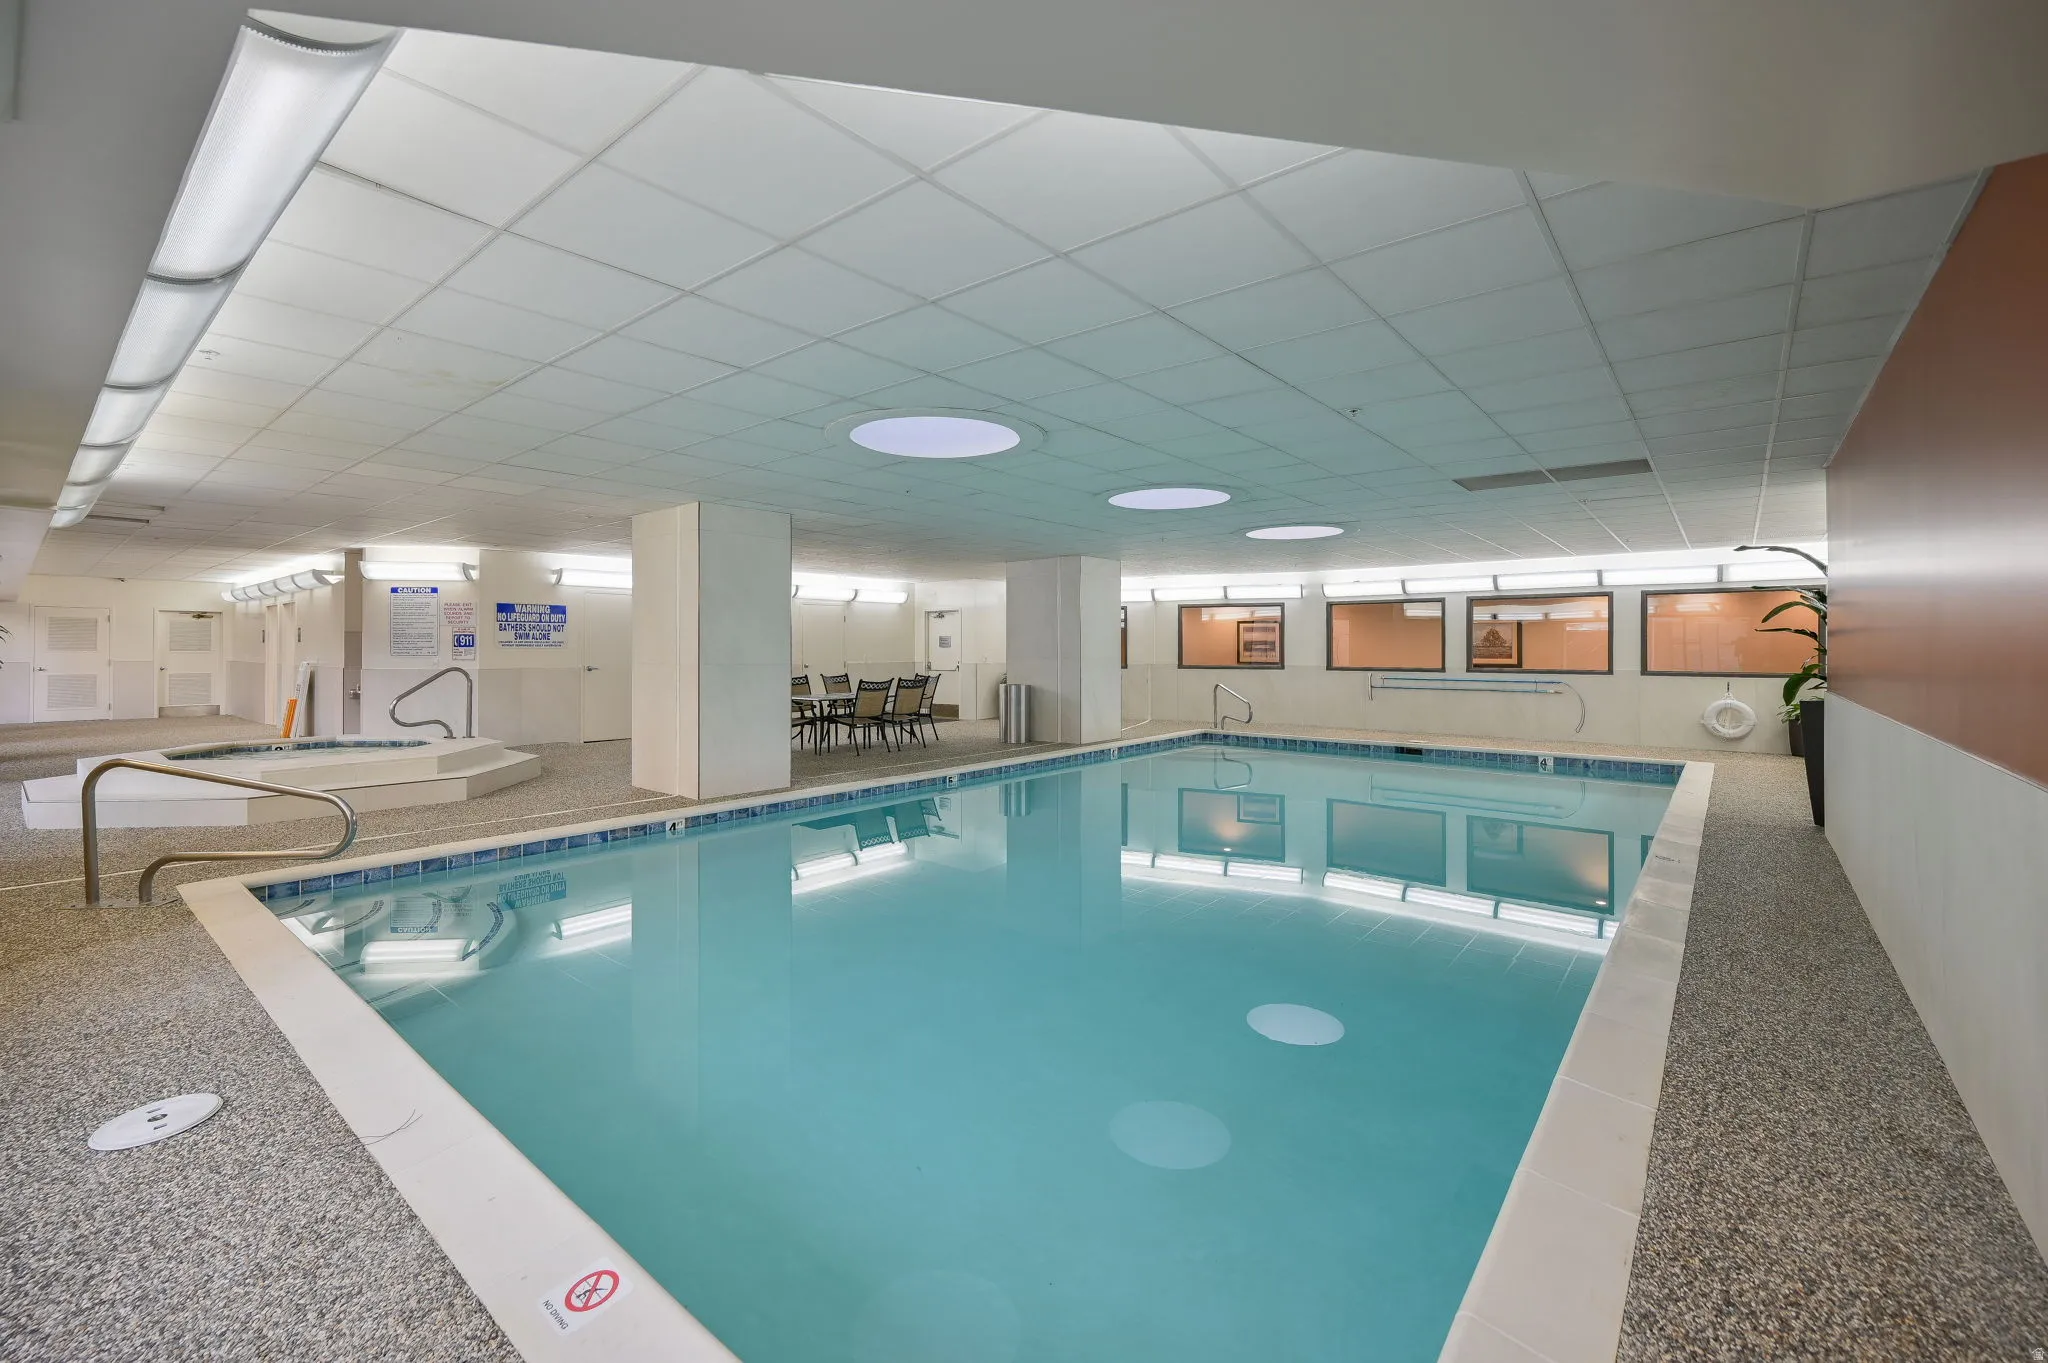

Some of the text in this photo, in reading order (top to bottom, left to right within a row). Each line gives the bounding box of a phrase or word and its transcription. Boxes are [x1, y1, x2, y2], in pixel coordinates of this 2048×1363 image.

[514, 604, 550, 613] WARNING
[497, 613, 566, 622] NO LIFEGUARD ON DUTY
[498, 623, 565, 632] BATHERS SHOULD NOT
[460, 635, 473, 646] 911
[514, 632, 551, 640] SWIM ALONE
[543, 1300, 568, 1330] NO DIVING
